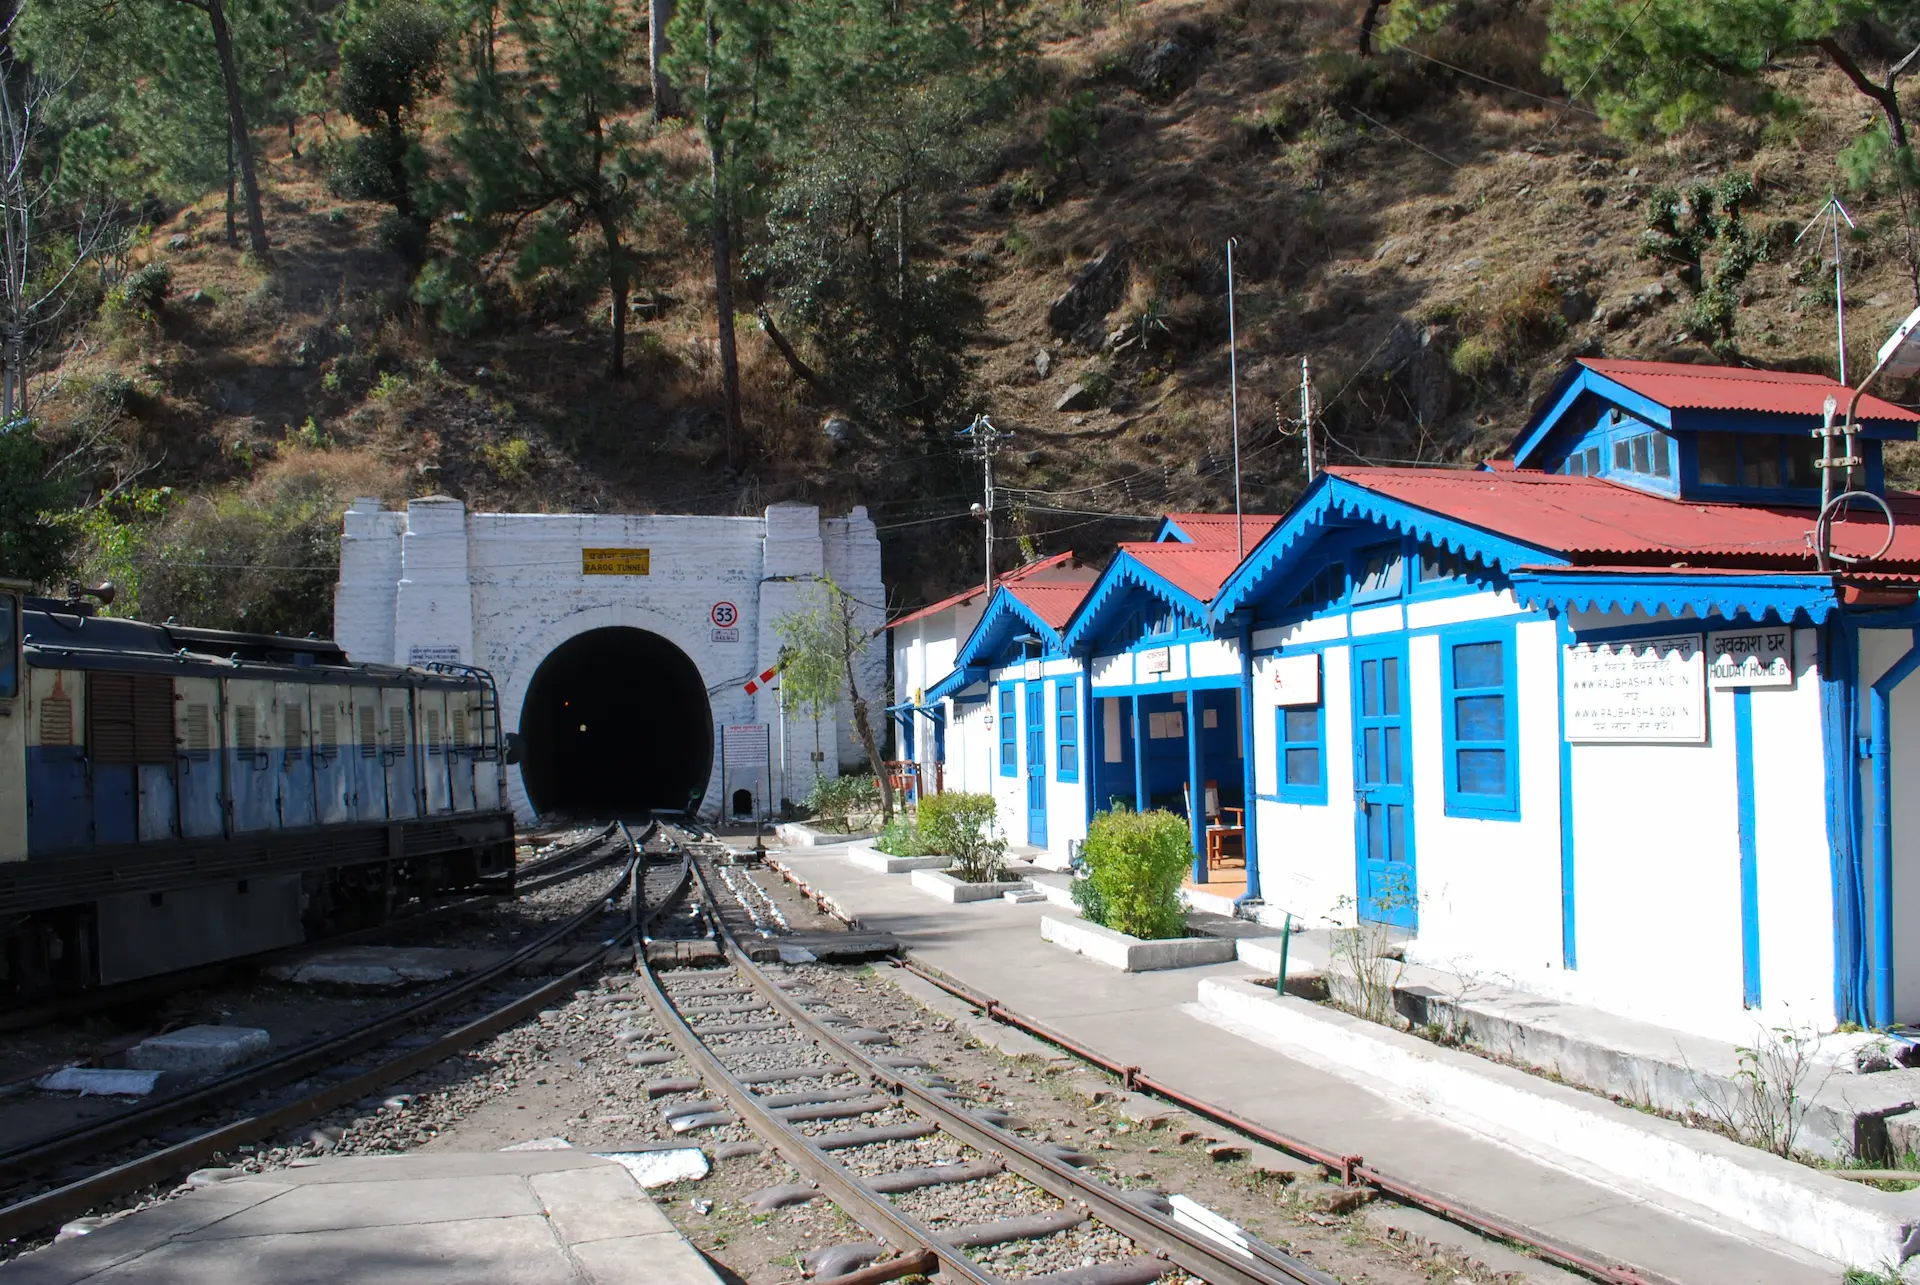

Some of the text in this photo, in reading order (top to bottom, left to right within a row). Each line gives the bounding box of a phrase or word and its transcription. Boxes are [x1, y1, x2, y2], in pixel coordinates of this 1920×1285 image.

[584, 563, 646, 572] BAROG TUNNEL
[717, 608, 732, 622] 33
[1713, 633, 1786, 655] अवकाश घर
[1710, 662, 1747, 679] HOLIDAY
[1750, 660, 1776, 677] HOME
